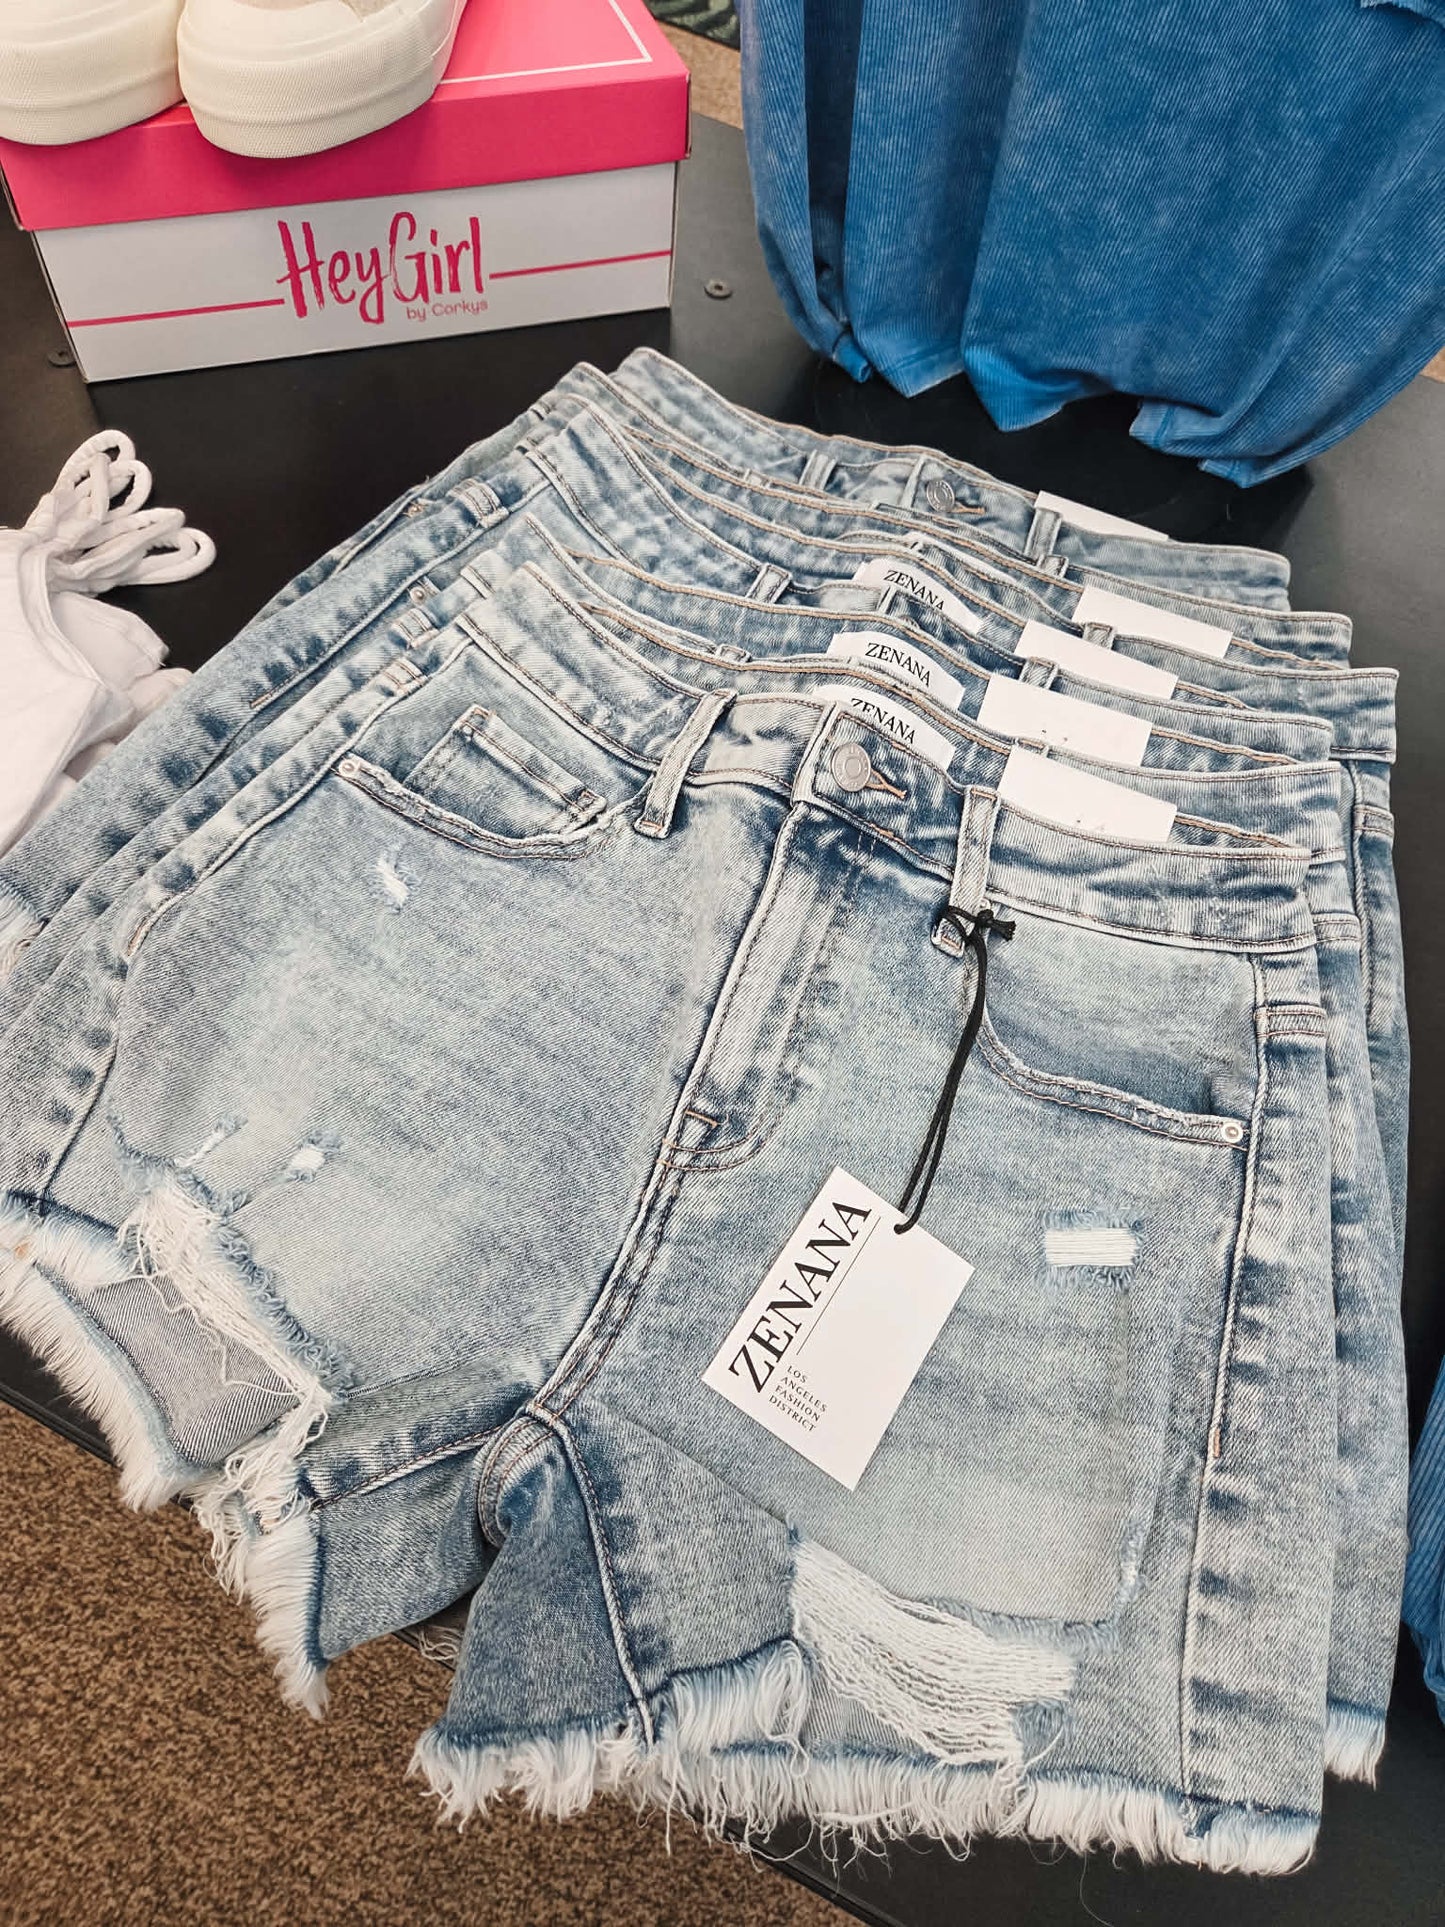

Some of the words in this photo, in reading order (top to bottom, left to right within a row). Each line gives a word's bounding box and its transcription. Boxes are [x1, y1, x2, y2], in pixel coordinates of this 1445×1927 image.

[406, 306, 426, 322] by
[431, 299, 488, 318] Corkys
[883, 569, 944, 610] ZENANA
[865, 642, 931, 687] ZENANA
[728, 1201, 872, 1393] ZENANA
[787, 1365, 807, 1383] LOS
[775, 1385, 820, 1421] FASHION
[781, 1377, 827, 1412] ANGELES
[769, 1395, 816, 1431] DISTRICT
